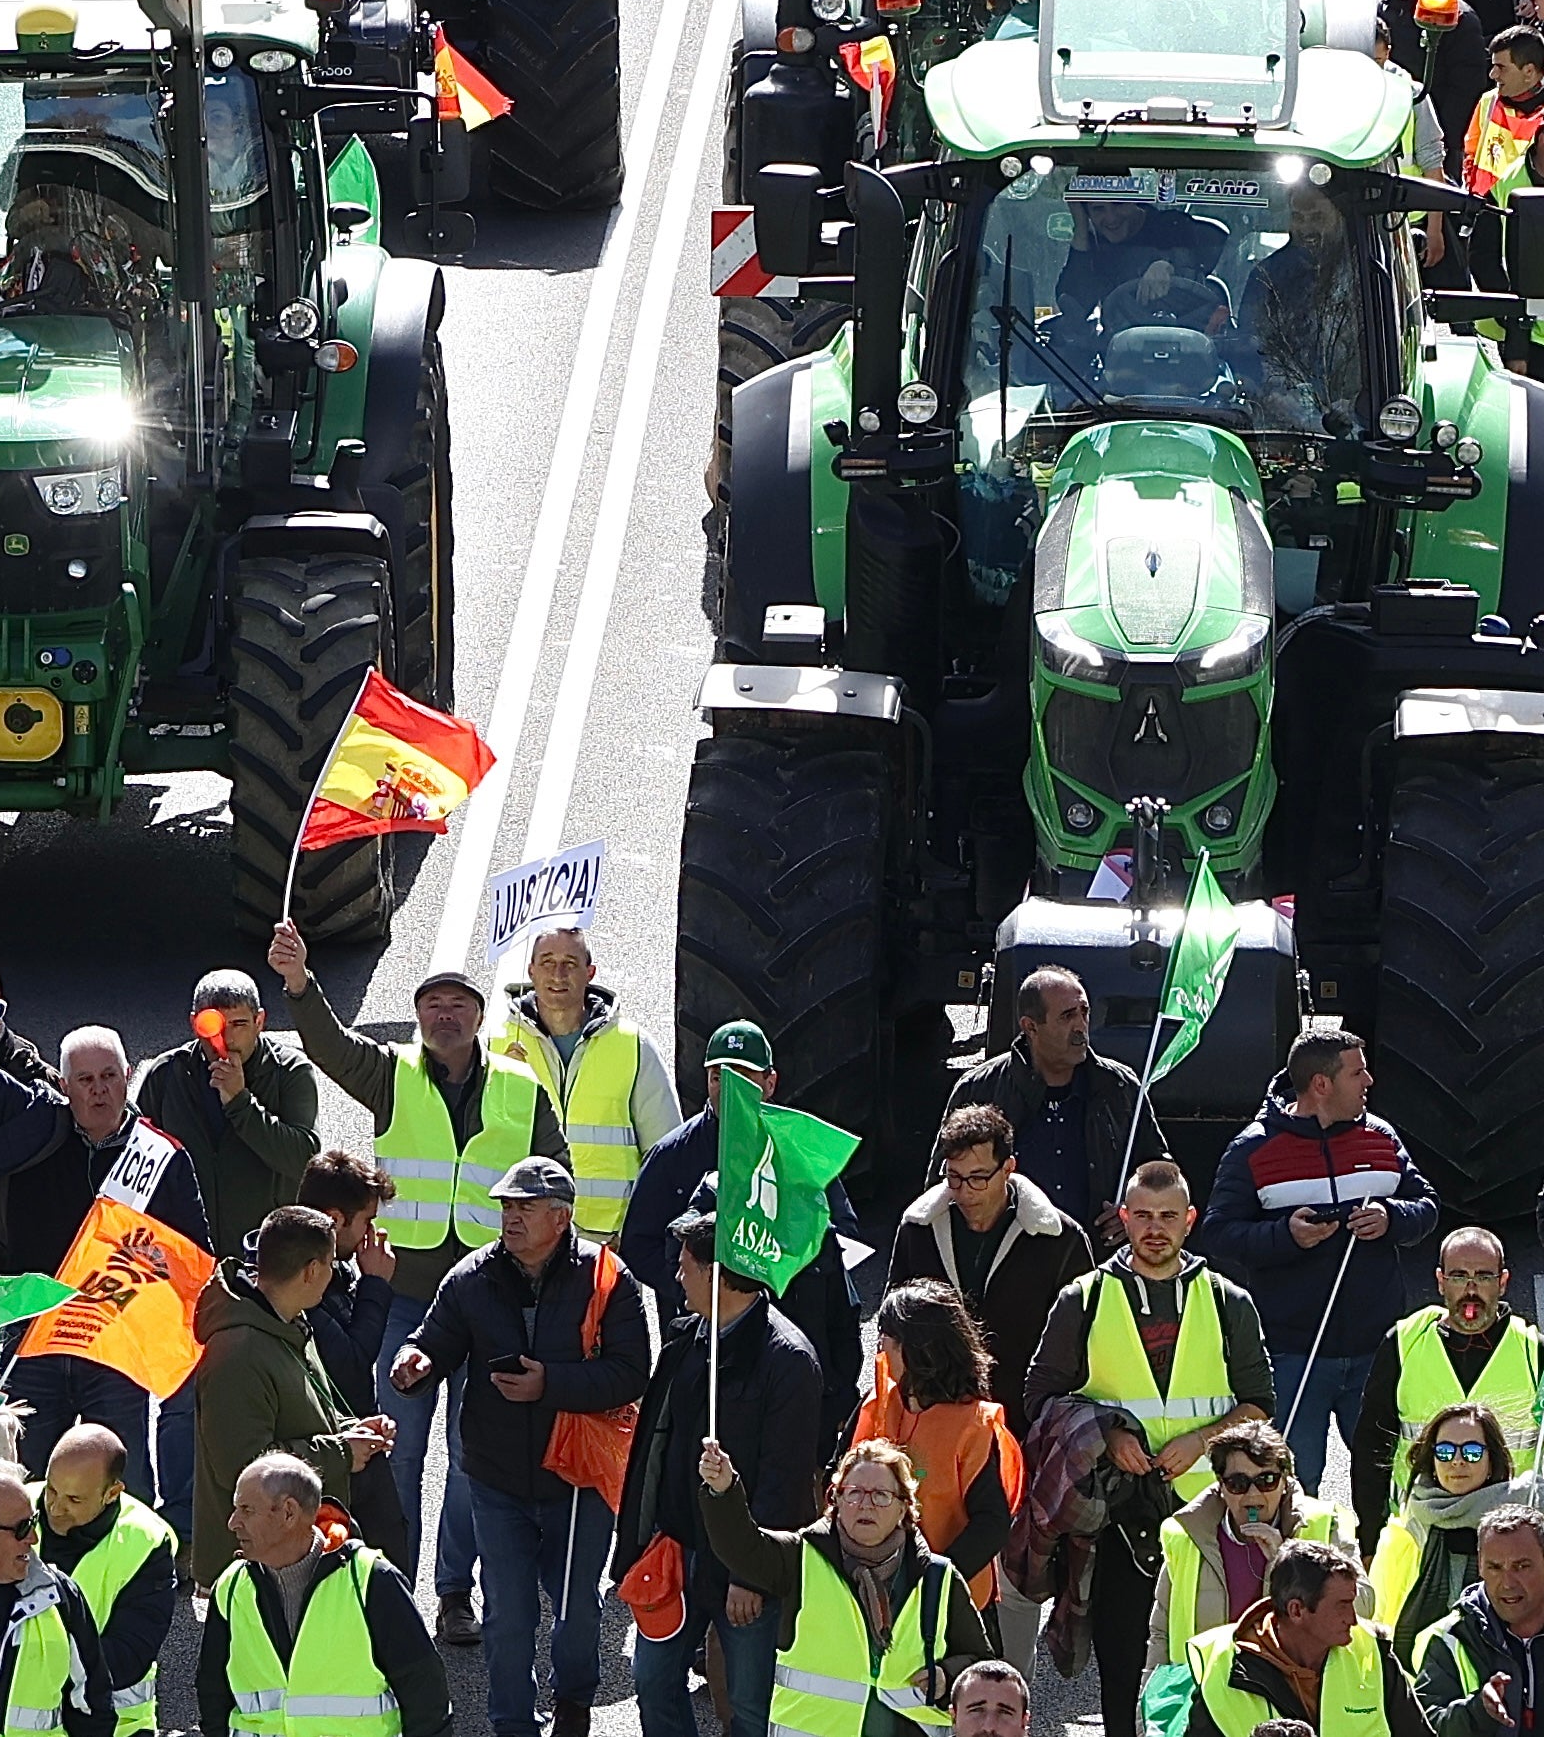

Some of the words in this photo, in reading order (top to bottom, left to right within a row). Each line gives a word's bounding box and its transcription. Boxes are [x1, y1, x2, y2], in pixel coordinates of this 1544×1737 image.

[1069, 175, 1148, 191] AGROMECANICA
[494, 854, 602, 947] ¡JUSTICIA!
[112, 1137, 170, 1198] icia!
[77, 1269, 139, 1313] UPA
